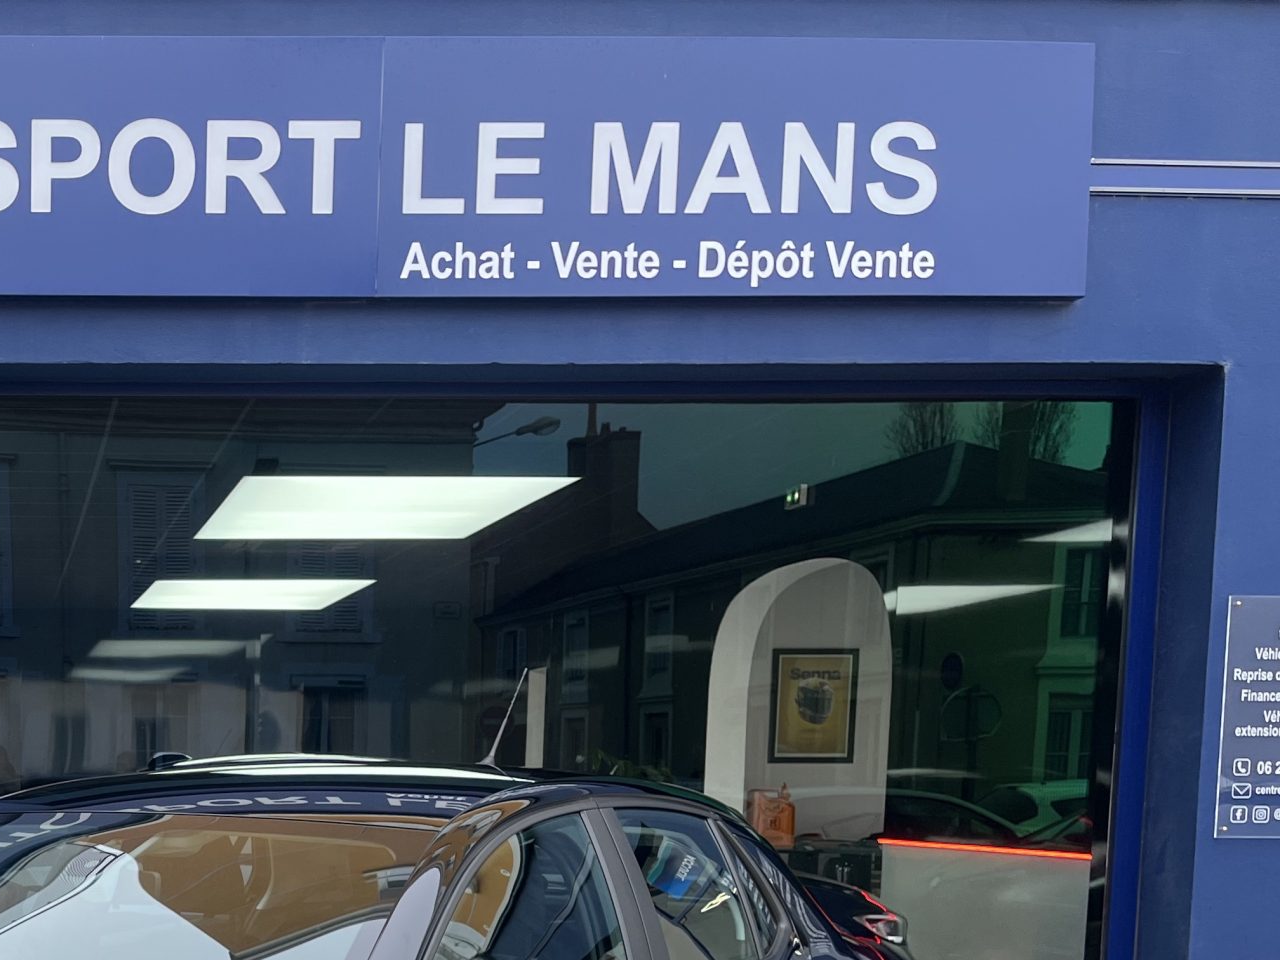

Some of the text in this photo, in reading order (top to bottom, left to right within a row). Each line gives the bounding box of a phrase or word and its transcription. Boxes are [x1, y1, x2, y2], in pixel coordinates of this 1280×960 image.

[402, 122, 545, 215] LE
[590, 121, 937, 216] MANS
[399, 241, 515, 280] Achat
[550, 241, 661, 279] Vente
[698, 240, 815, 288] Dépôt
[825, 240, 935, 280] Vente
[790, 667, 841, 681] Senna
[1233, 668, 1273, 683] Reprise
[1234, 724, 1280, 737] extensio
[1257, 760, 1272, 775] 06
